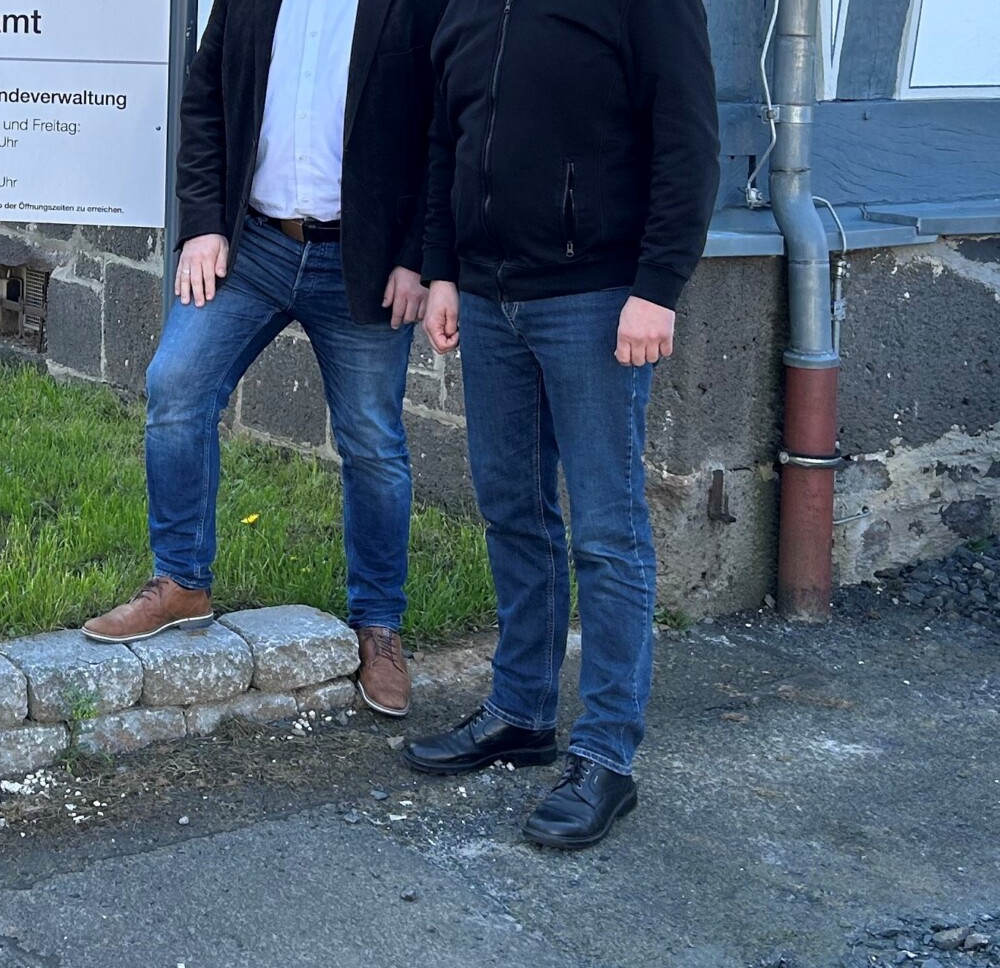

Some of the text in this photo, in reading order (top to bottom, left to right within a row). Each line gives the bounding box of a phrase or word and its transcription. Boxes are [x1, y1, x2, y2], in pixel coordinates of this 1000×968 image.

[3, 119, 28, 130] und
[33, 119, 80, 135] Freitag:
[4, 202, 17, 210] der
[19, 201, 74, 212] Öffnungszeiten
[76, 205, 85, 213] zu
[87, 206, 124, 214] erreichen.
